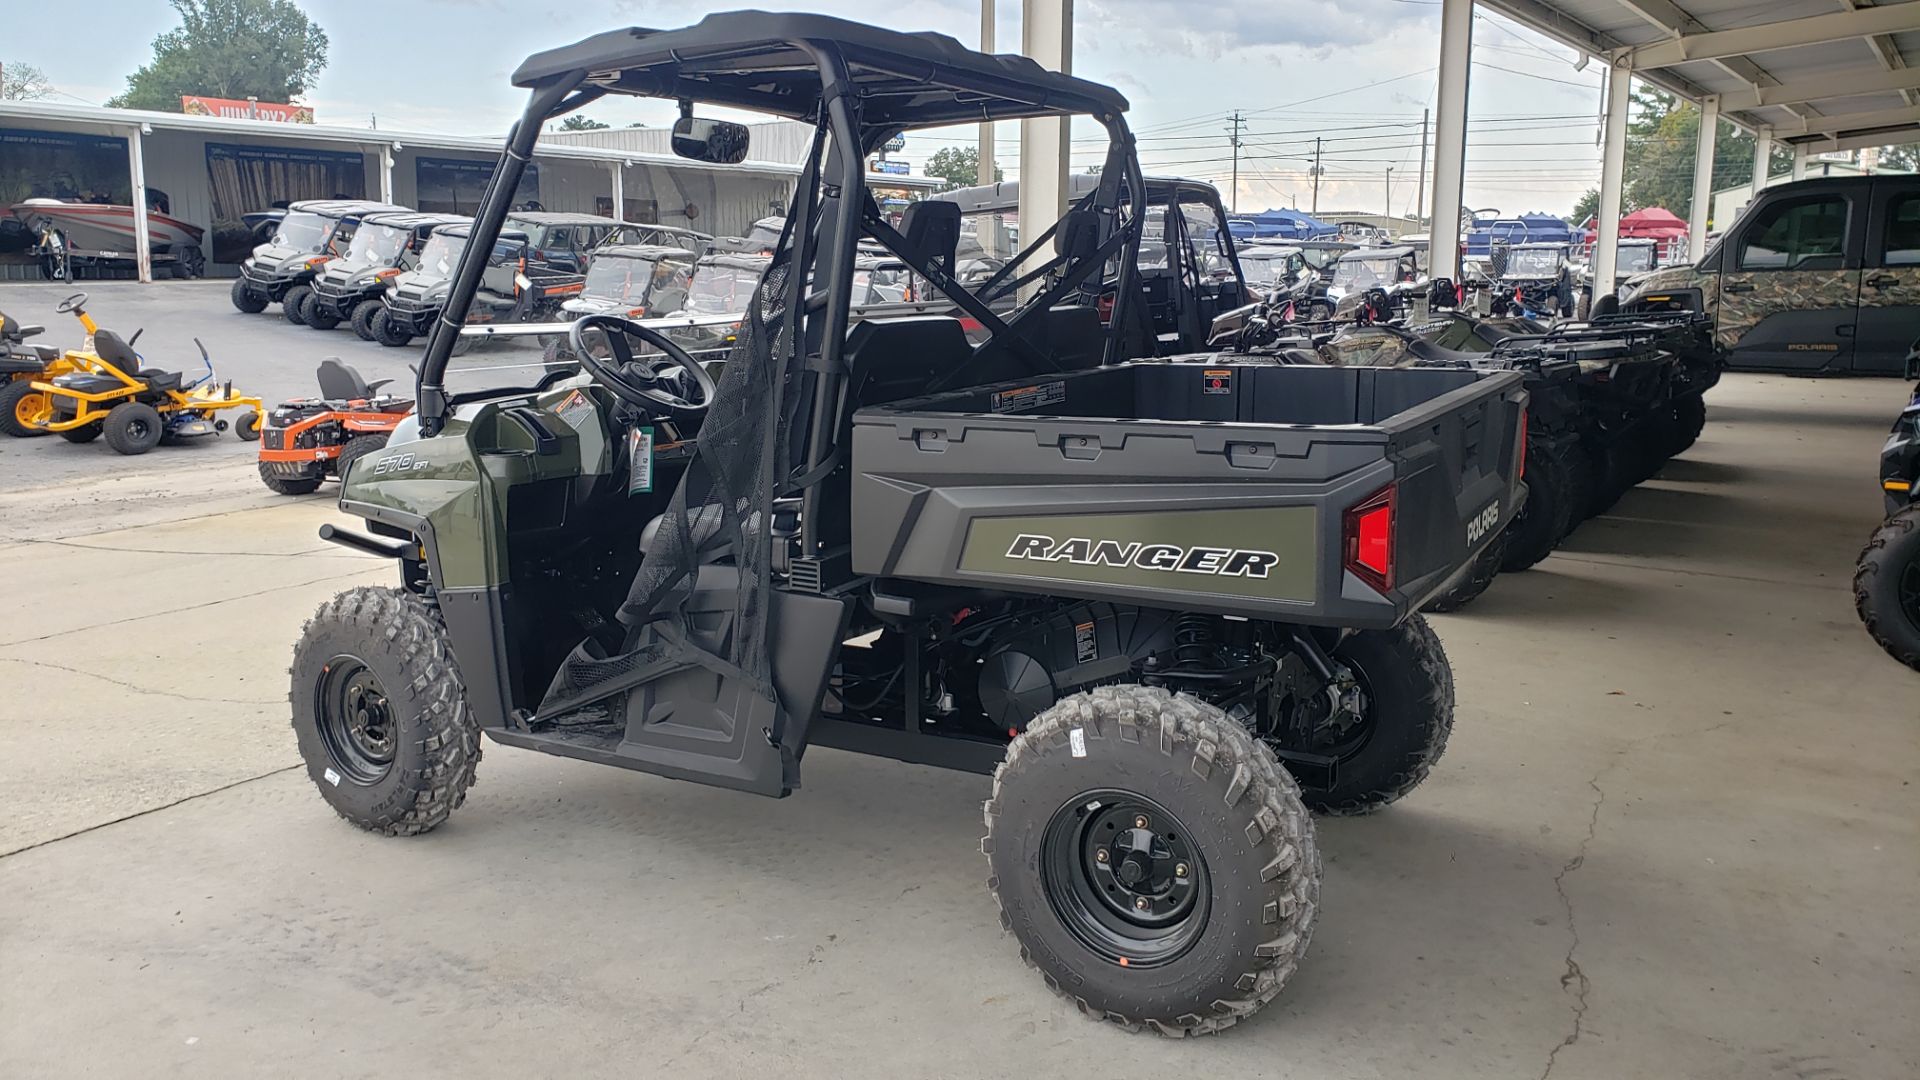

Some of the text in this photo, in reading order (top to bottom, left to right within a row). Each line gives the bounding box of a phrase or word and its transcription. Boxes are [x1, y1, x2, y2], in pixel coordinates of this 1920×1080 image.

[1787, 343, 1838, 351] POLARIS
[374, 453, 429, 475] 570 EFI
[1467, 499, 1499, 548] POLARIS
[1005, 533, 1280, 579] RANGER
